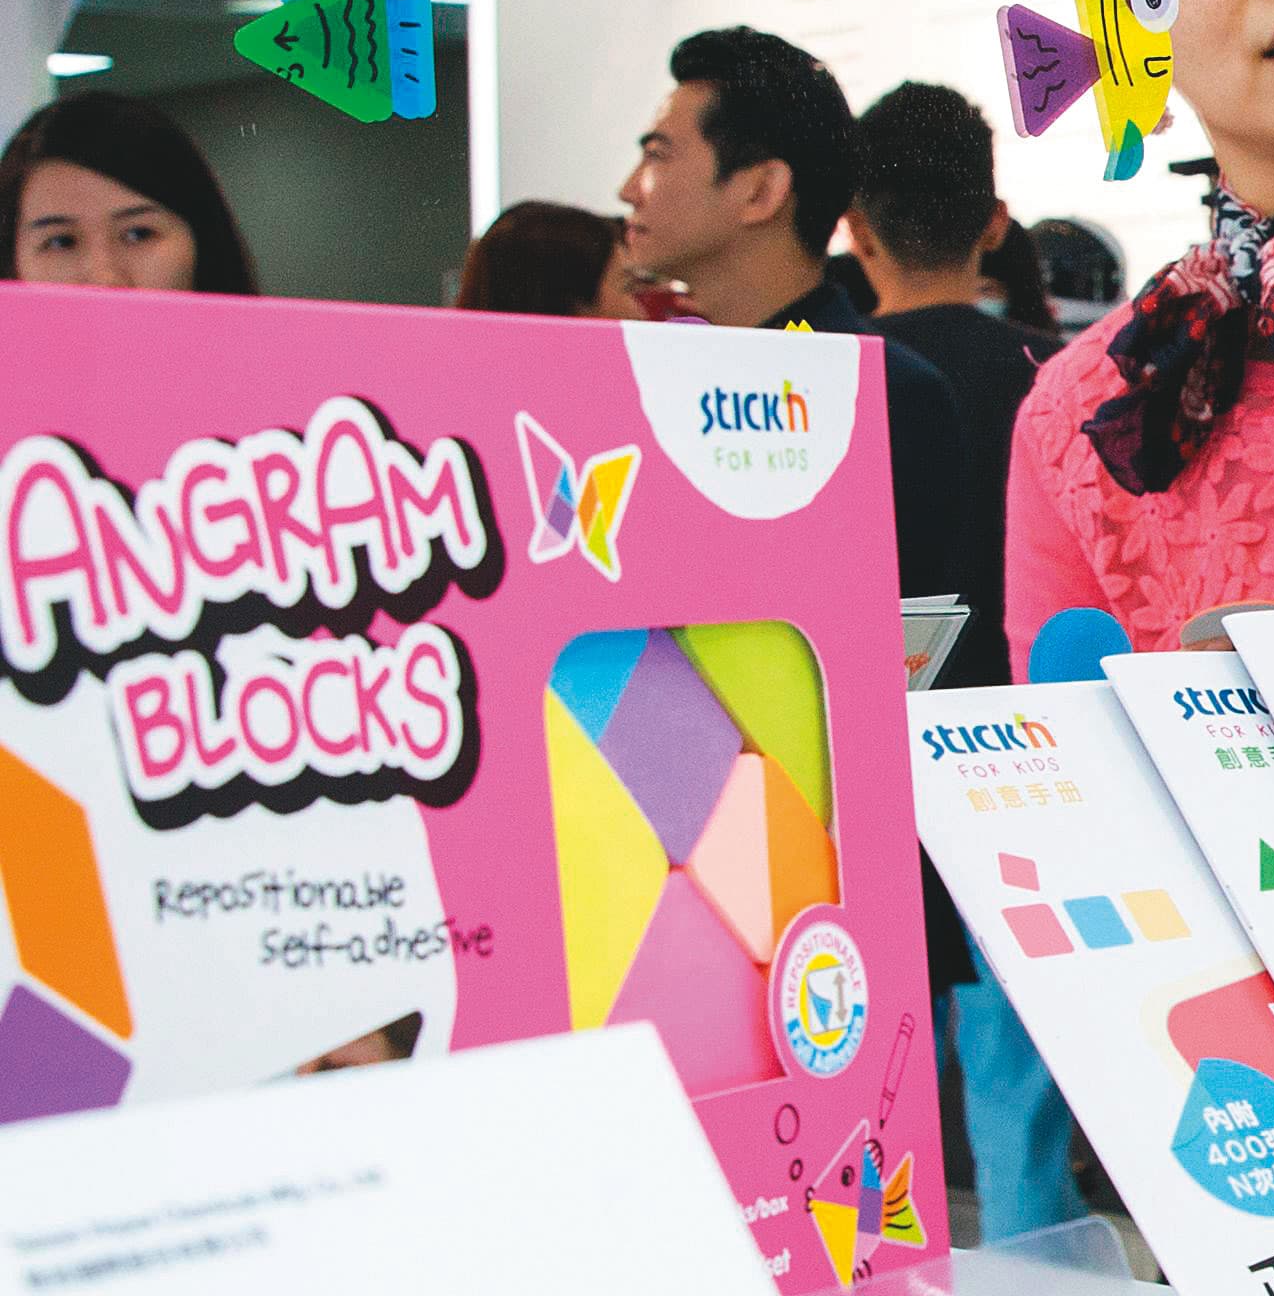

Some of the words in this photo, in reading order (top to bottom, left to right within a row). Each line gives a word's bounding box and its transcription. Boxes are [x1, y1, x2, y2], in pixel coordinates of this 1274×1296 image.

[714, 446, 752, 470] FOR
[767, 447, 809, 471] KIDS
[125, 642, 450, 779] BLOCKS
[1206, 724, 1246, 738] FOR
[957, 762, 1000, 779] FOR
[1012, 757, 1061, 775] KIDS
[154, 869, 405, 921] Repositionable
